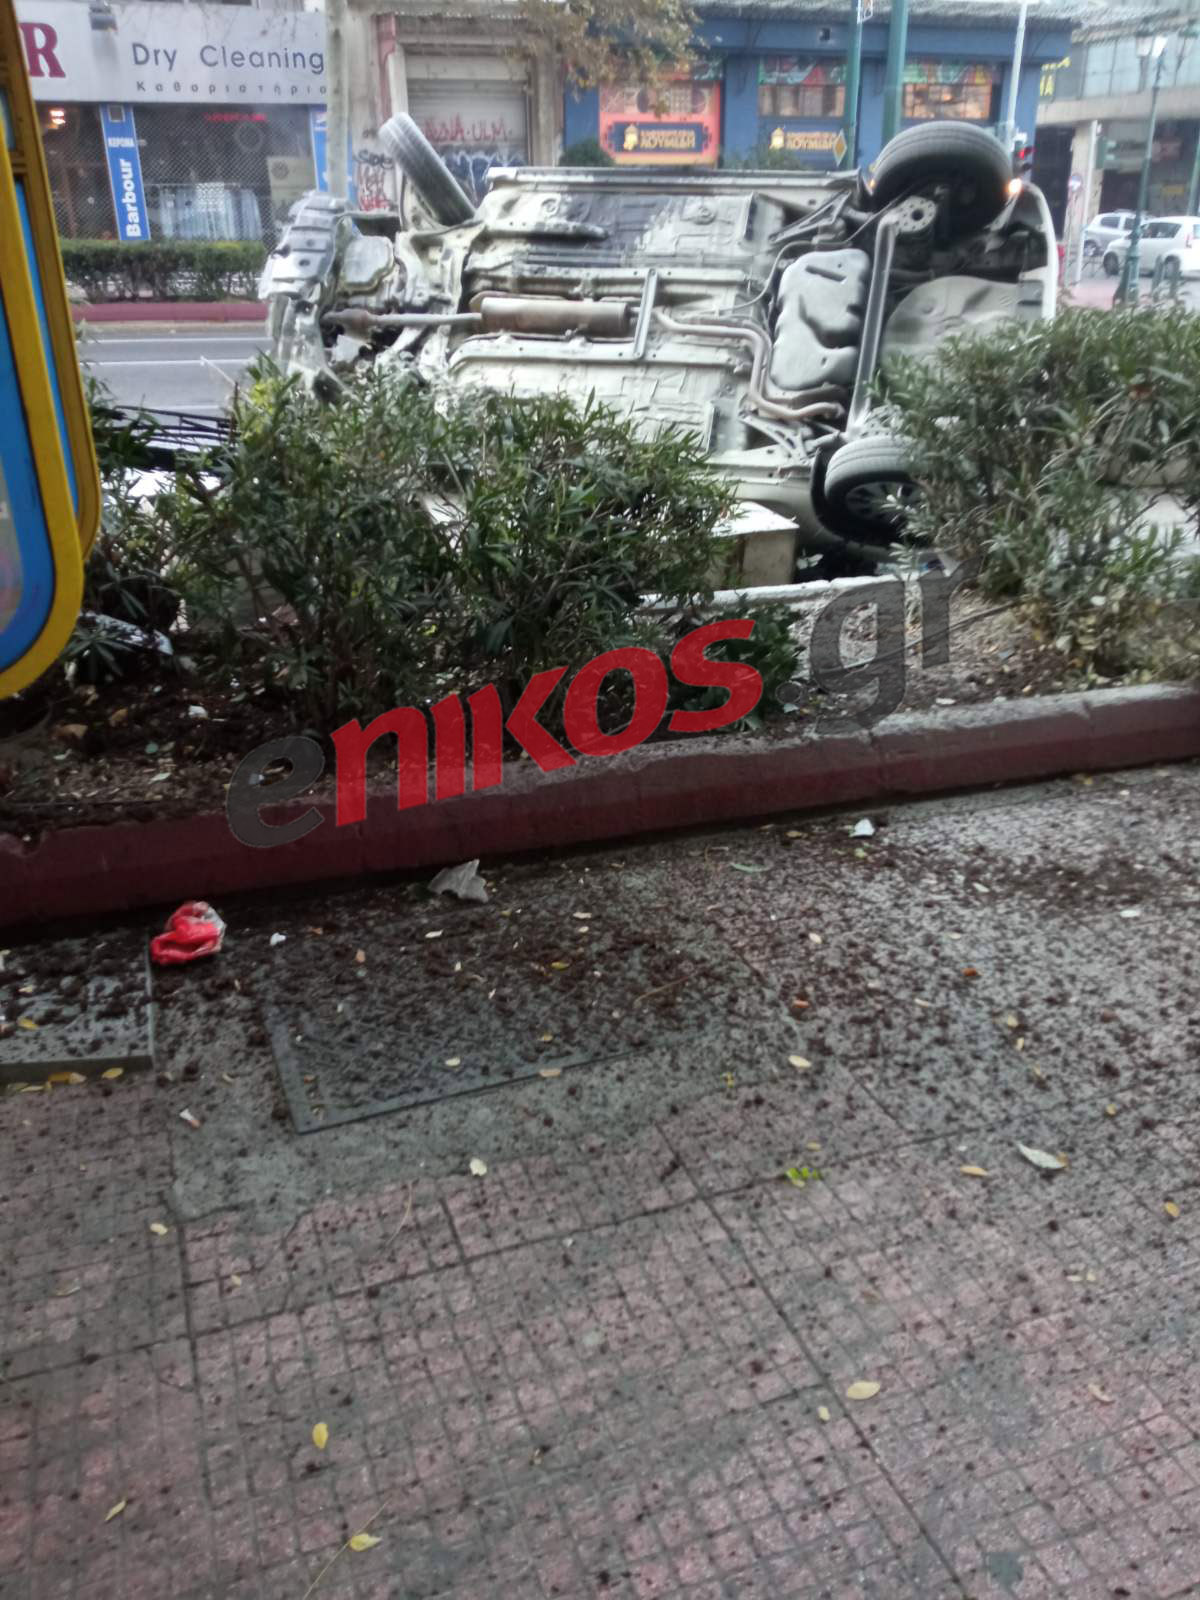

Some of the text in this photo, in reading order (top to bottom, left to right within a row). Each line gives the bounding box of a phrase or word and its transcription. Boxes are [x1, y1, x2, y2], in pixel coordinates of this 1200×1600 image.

[132, 42, 324, 75] Dry Cleaning
[119, 158, 142, 237] Barbour
